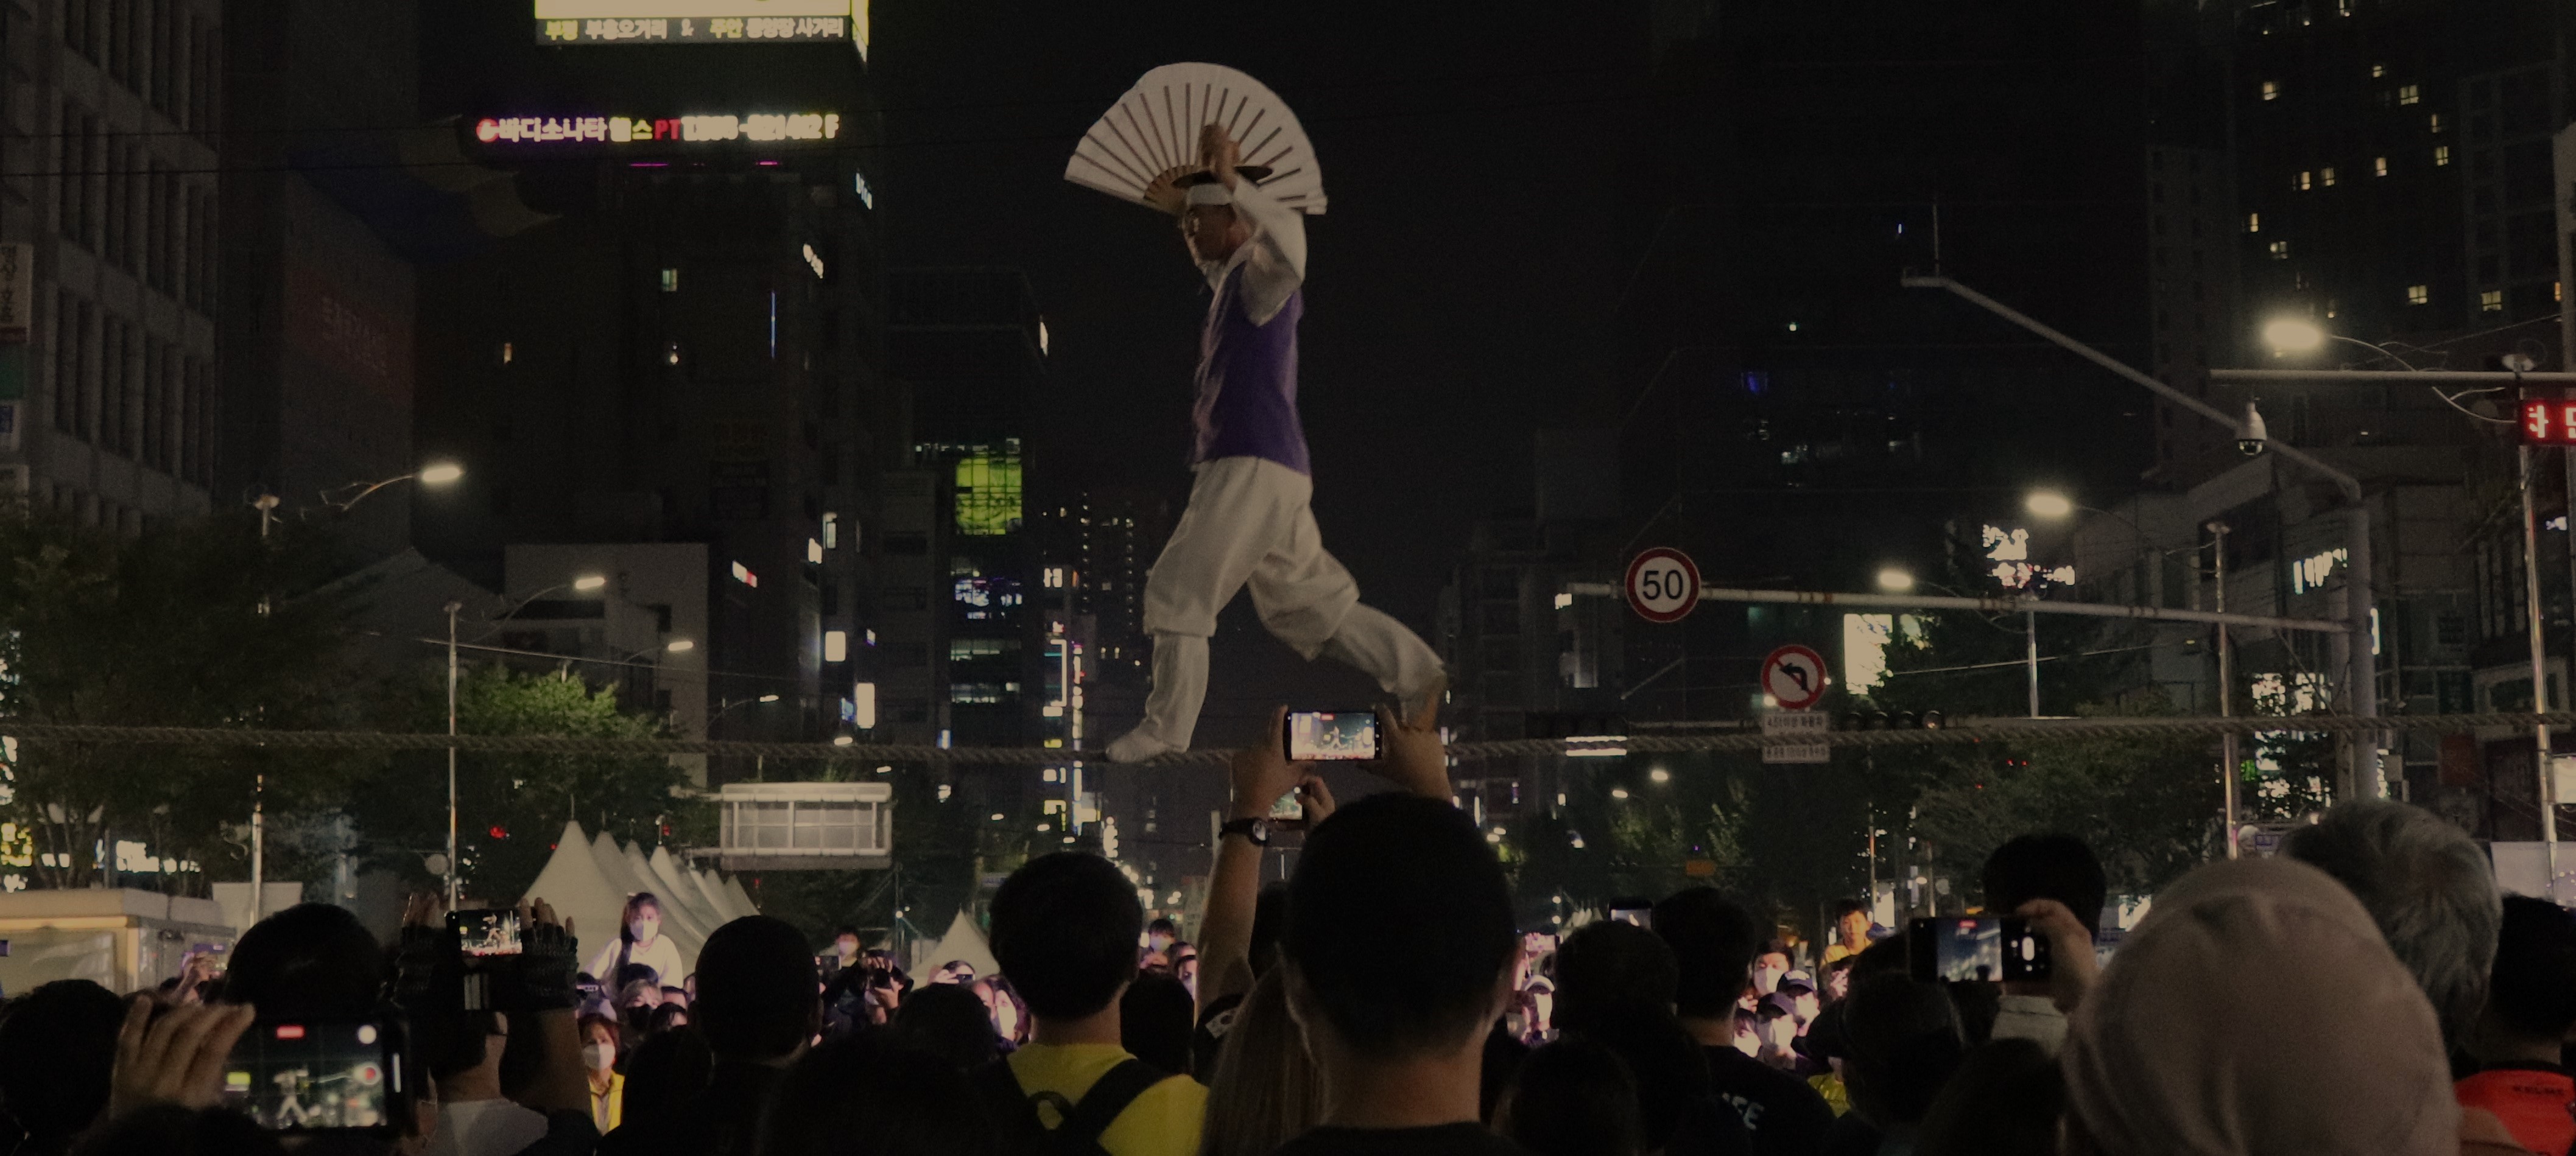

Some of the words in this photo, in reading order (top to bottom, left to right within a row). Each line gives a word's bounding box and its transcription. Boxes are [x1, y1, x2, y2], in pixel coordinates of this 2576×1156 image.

[545, 20, 578, 41] 부평
[709, 18, 744, 38] 주안
[498, 116, 607, 142] 바디소나타
[654, 119, 681, 141] PT
[1642, 570, 1684, 601] 50
